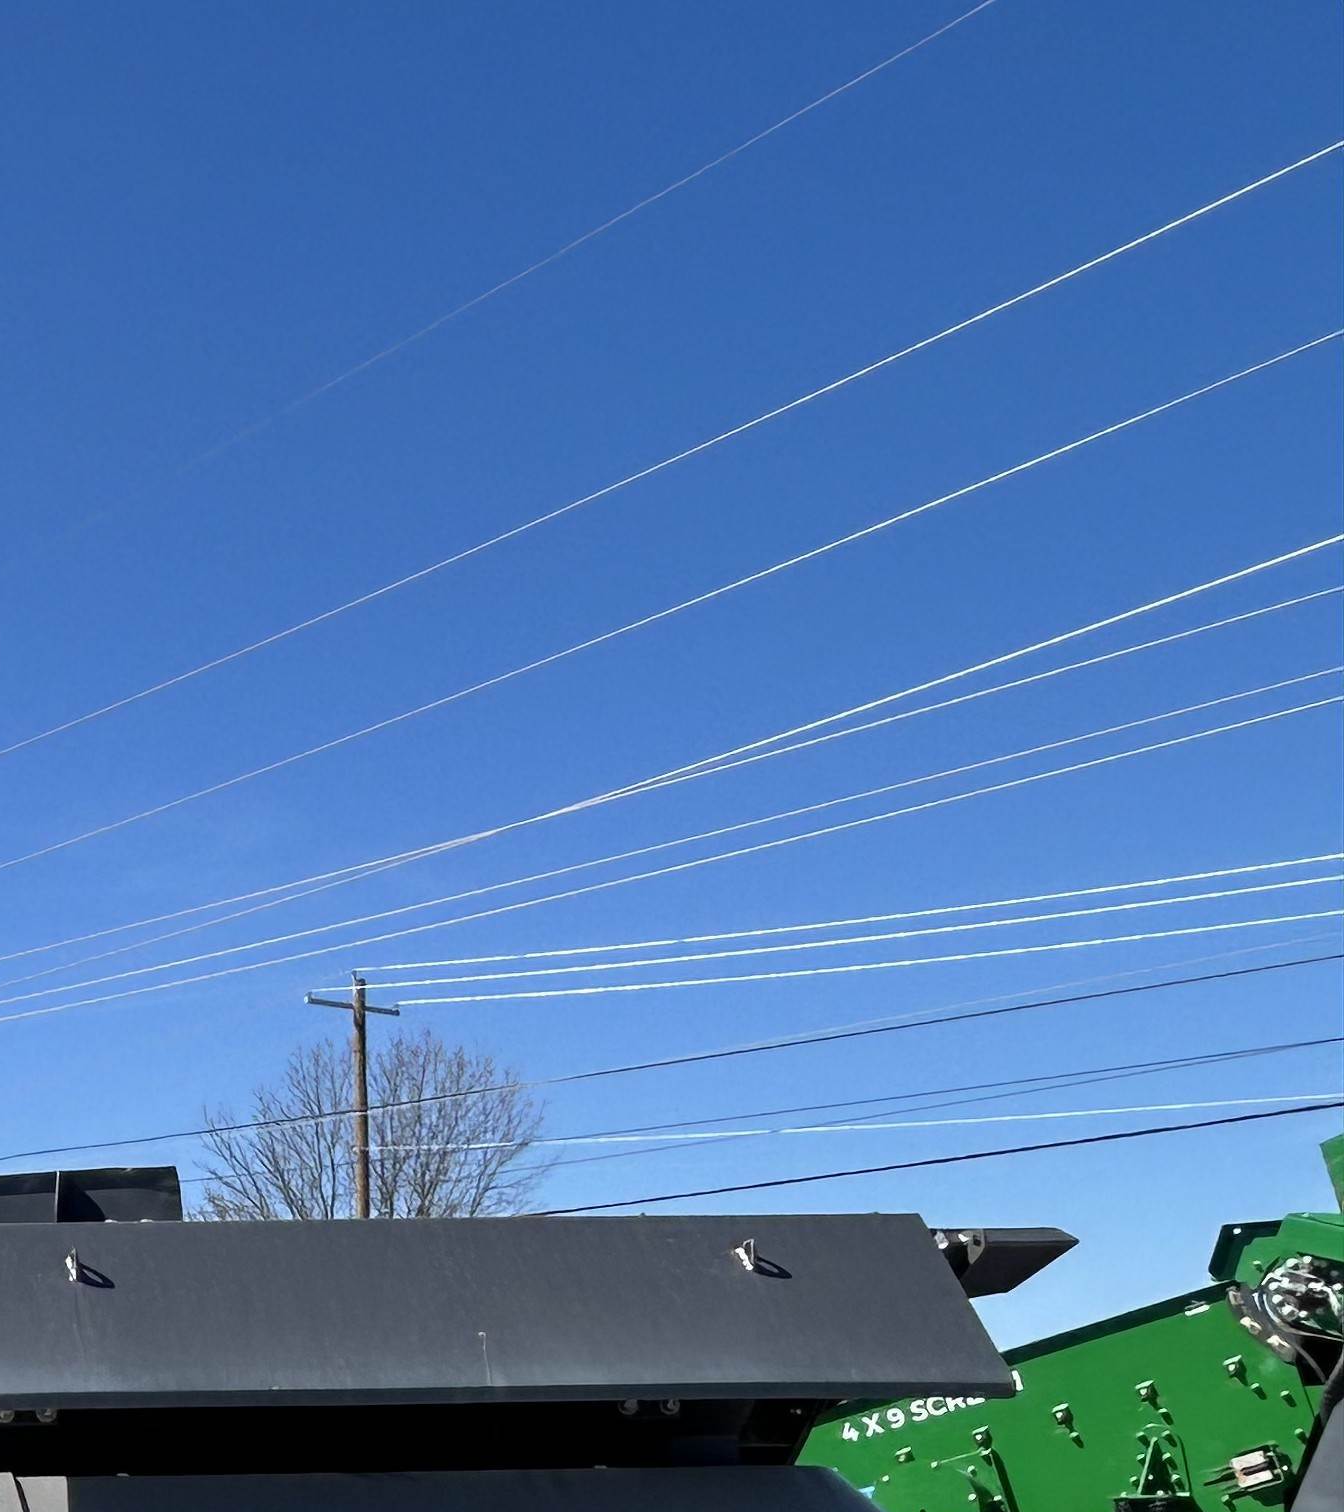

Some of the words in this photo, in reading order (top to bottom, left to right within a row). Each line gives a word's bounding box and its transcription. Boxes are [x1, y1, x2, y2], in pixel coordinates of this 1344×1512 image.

[842, 1422, 860, 1441] 4
[862, 1413, 886, 1437] X
[887, 1408, 905, 1429] 9
